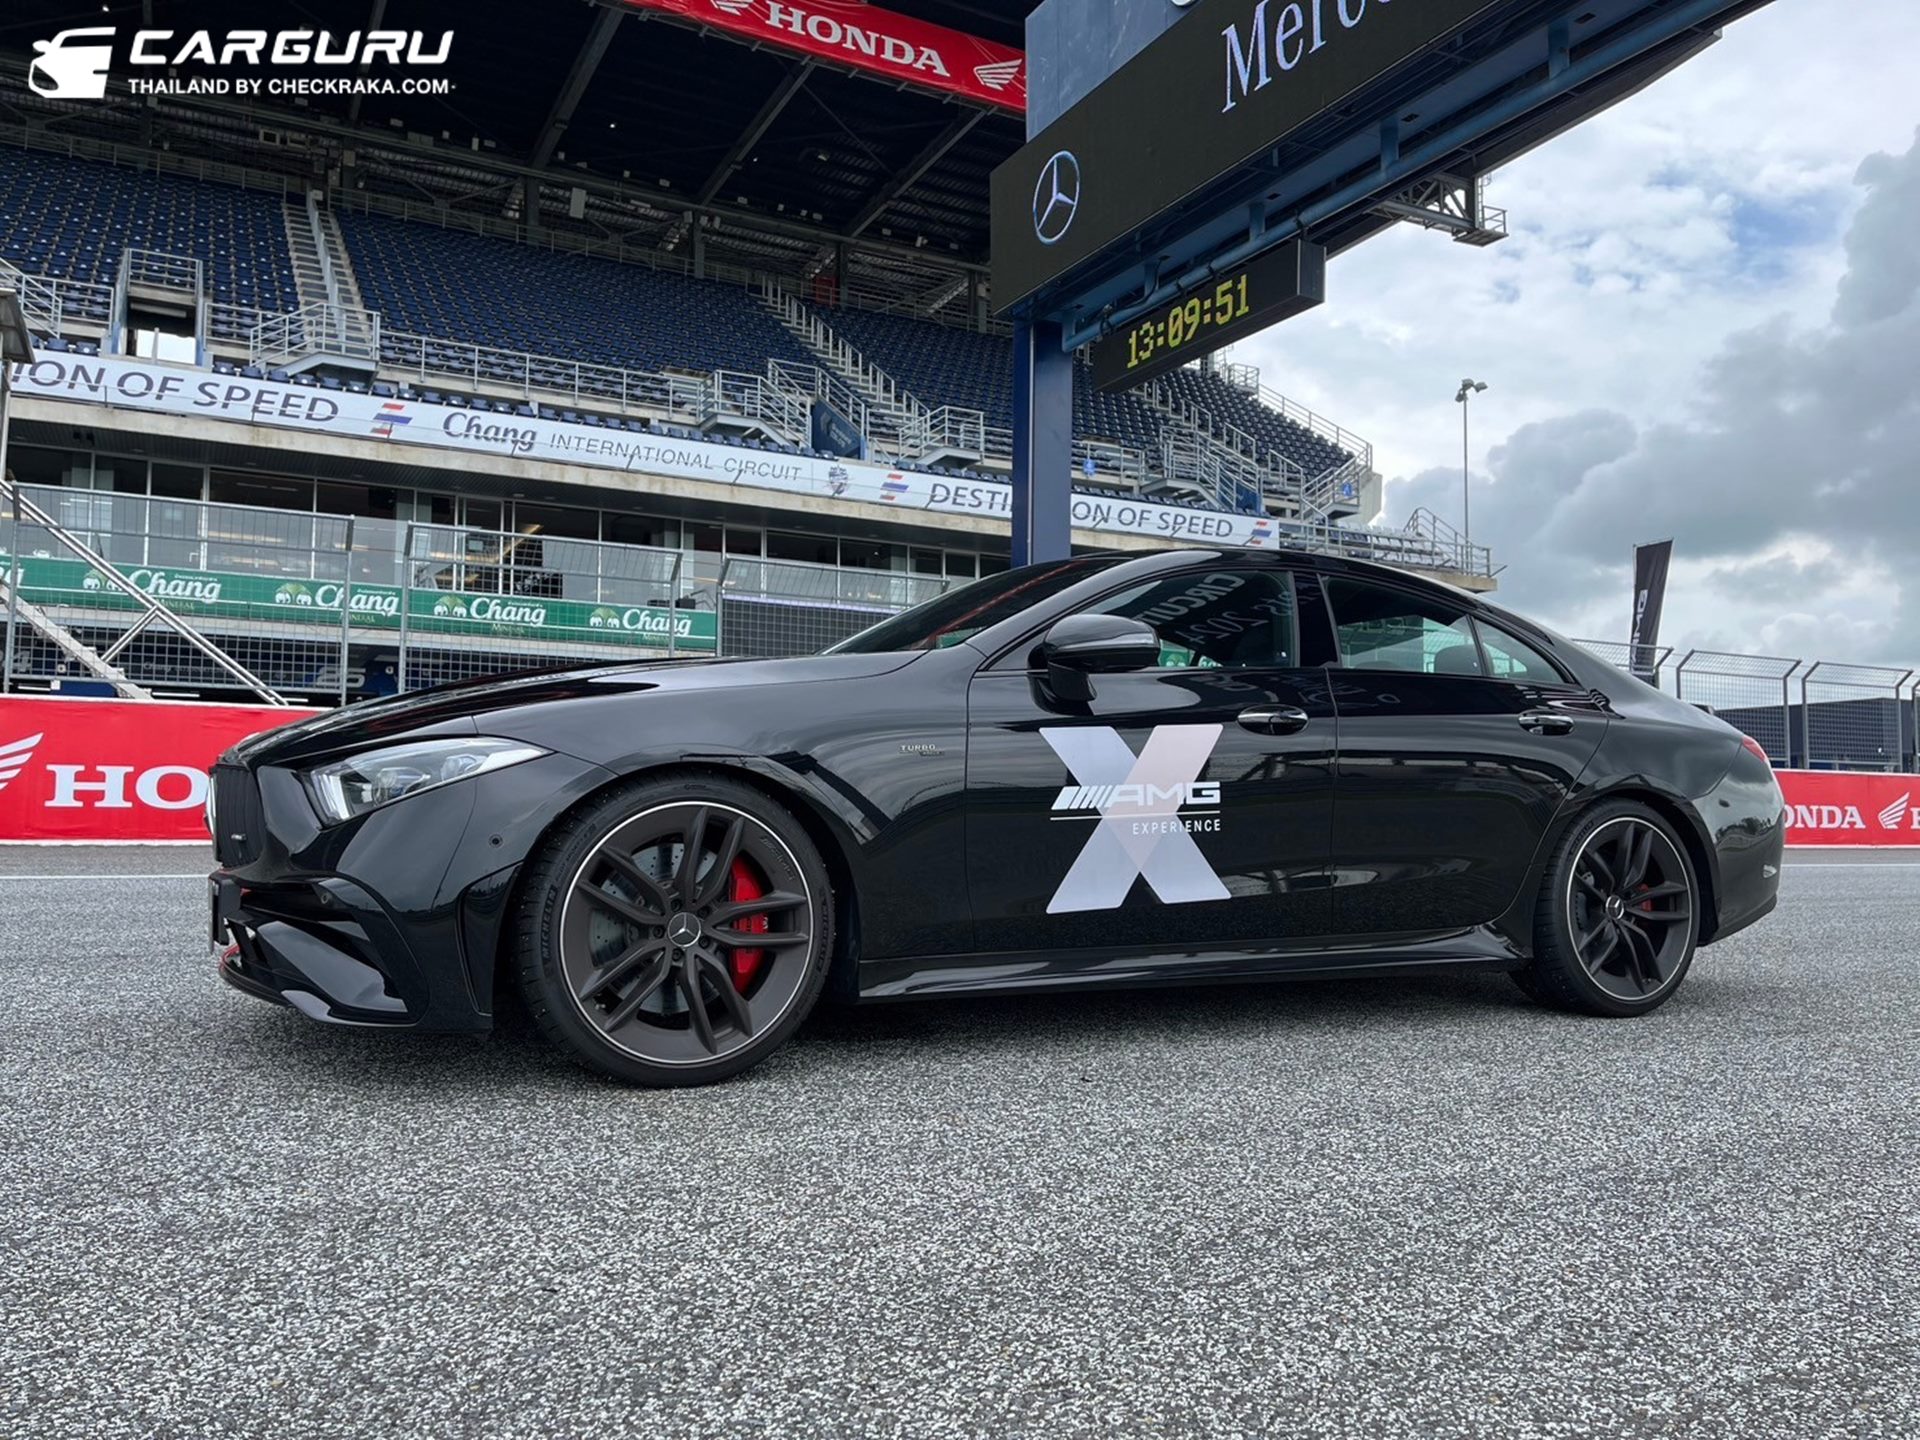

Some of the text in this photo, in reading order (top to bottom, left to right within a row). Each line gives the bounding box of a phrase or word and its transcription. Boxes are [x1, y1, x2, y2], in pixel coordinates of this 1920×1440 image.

[765, 0, 951, 77] HONDA
[1127, 274, 1249, 368] 13:09:51
[117, 371, 185, 401] OF
[193, 381, 339, 423] SPEED
[442, 411, 803, 482] Chang INTERNATIONAL CIRCUIT
[1117, 507, 1152, 528] OF
[1157, 511, 1233, 538] SPEED
[128, 569, 222, 604] Chang
[469, 597, 546, 628] Chang
[622, 608, 692, 637] Chang
[1104, 781, 1221, 808] AMG
[1132, 819, 1221, 835] EXPERIENCE
